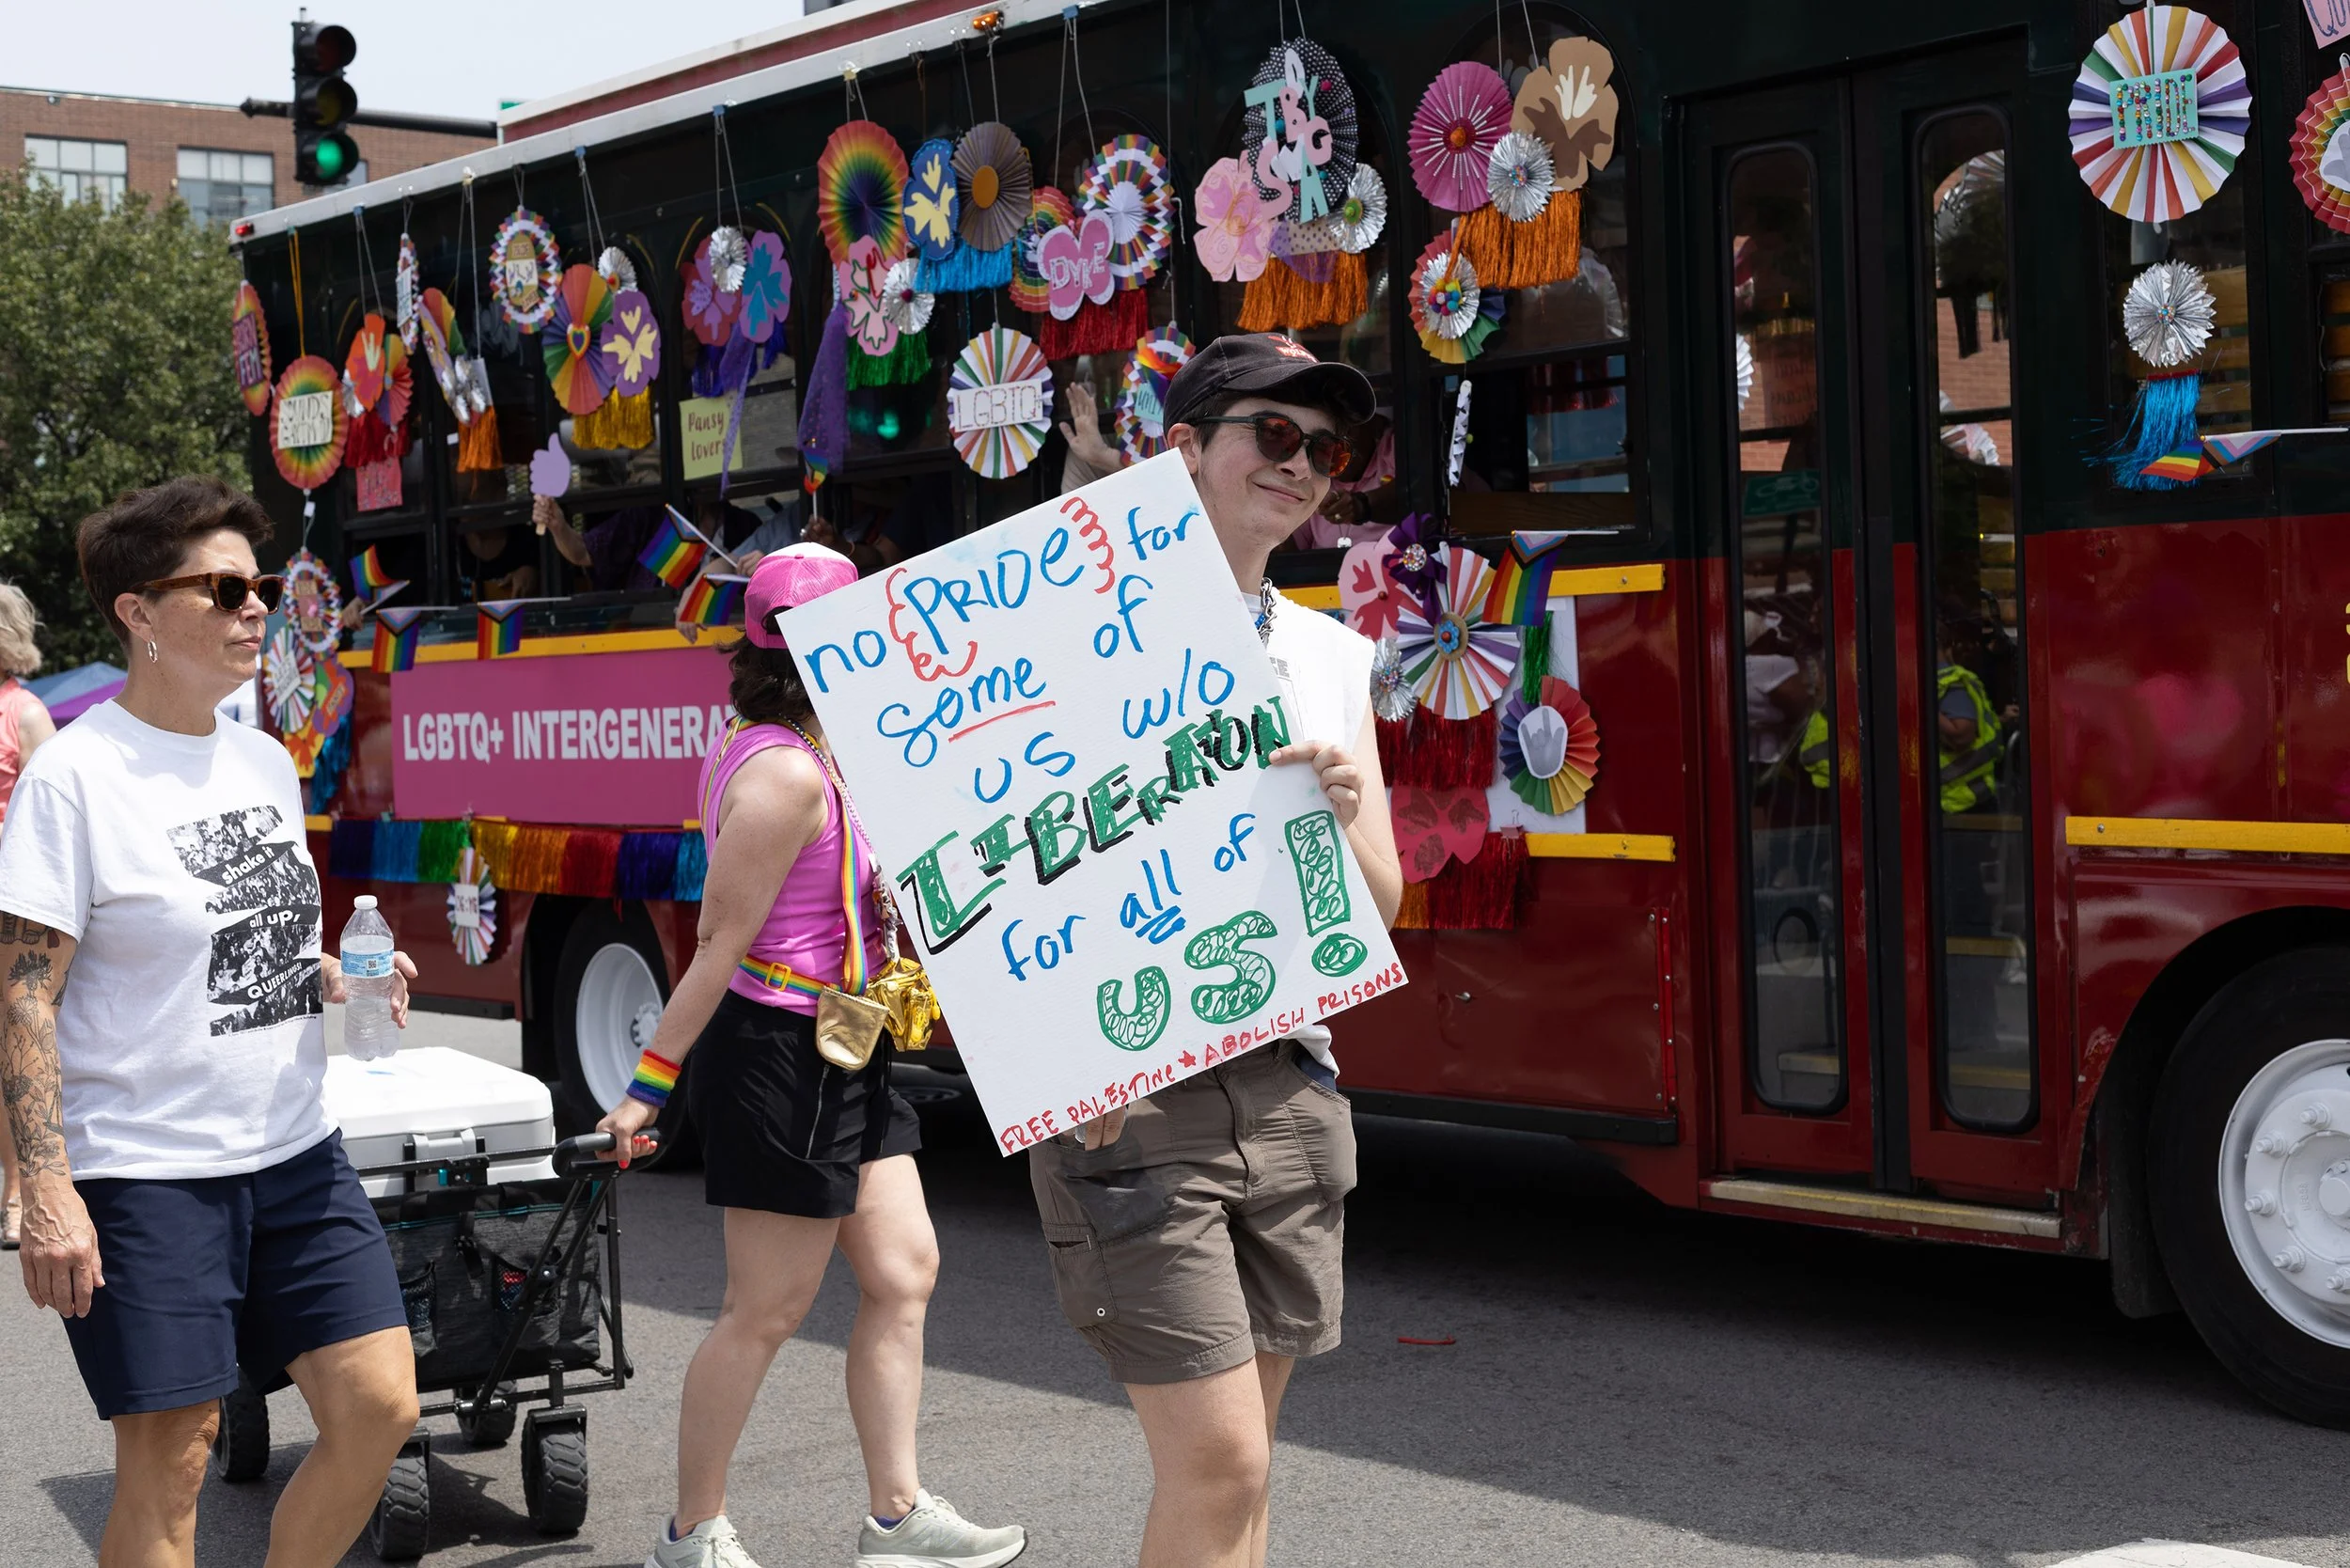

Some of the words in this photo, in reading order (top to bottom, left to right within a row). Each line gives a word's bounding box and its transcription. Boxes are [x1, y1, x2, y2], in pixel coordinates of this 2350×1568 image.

[2116, 74, 2195, 141] PRIDE
[1048, 241, 1105, 290] DYKE
[687, 412, 724, 435] Pansy
[804, 630, 886, 693] no
[1127, 507, 1199, 560] for
[877, 658, 1046, 767] some
[1093, 574, 1153, 658] of
[1122, 648, 1235, 739] w/o
[403, 712, 504, 764] LGBTQ+
[512, 705, 736, 760] INTERGENERA
[222, 854, 265, 885] shake
[262, 846, 275, 858] it
[1001, 915, 1087, 981] for
[1120, 849, 1183, 930] all
[1214, 813, 1256, 872] of
[249, 913, 263, 928] all
[267, 910, 301, 927] up,
[247, 962, 303, 999] QUEERLINGS!
[1000, 1109, 1059, 1154] FREE
[1203, 1007, 1306, 1068] ABOLISH
[1317, 963, 1402, 1015] PRISONS
